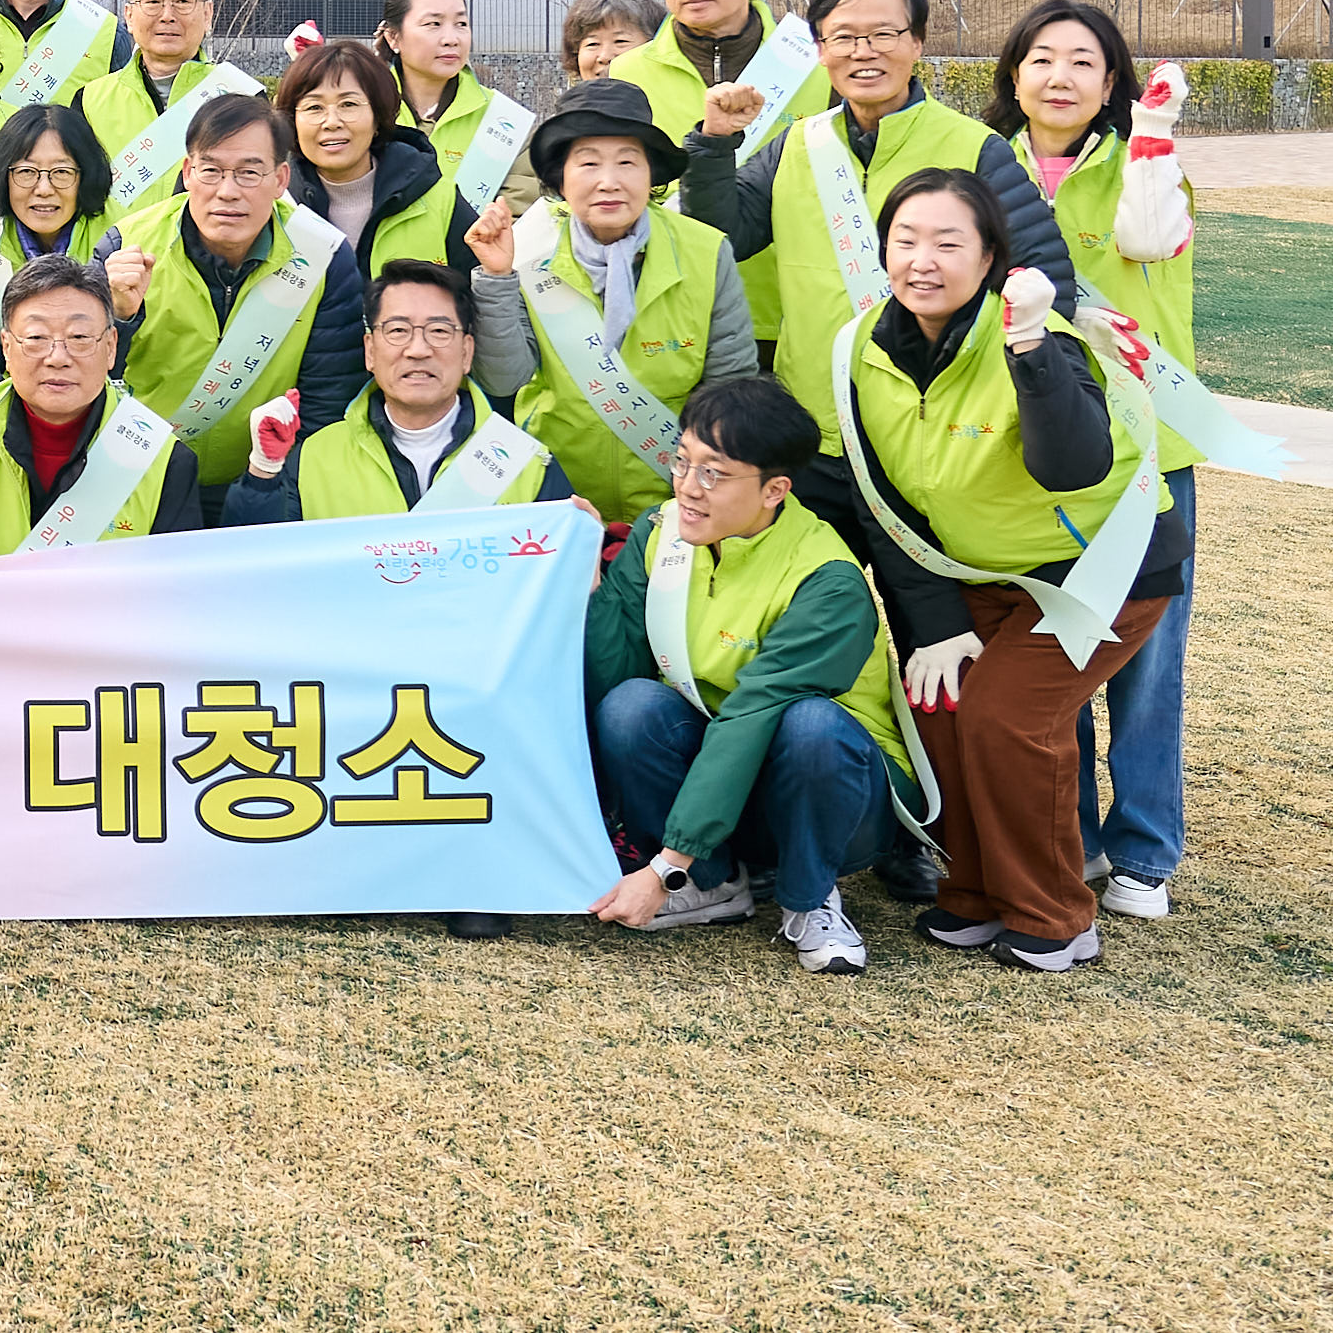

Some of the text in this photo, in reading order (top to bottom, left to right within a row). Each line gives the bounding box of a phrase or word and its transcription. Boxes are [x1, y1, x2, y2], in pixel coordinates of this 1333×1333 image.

[14, 46, 55, 92] 우리가
[29, 72, 58, 104] 깨끗
[122, 165, 154, 204] 깨끗
[830, 212, 862, 278] 쓰레기
[189, 357, 233, 414] 쓰레기
[586, 378, 637, 433] 쓰레기
[116, 423, 151, 451] 클린강동
[472, 448, 505, 479] 클린강동
[447, 537, 500, 574] 강동
[24, 680, 493, 844] 대청소
